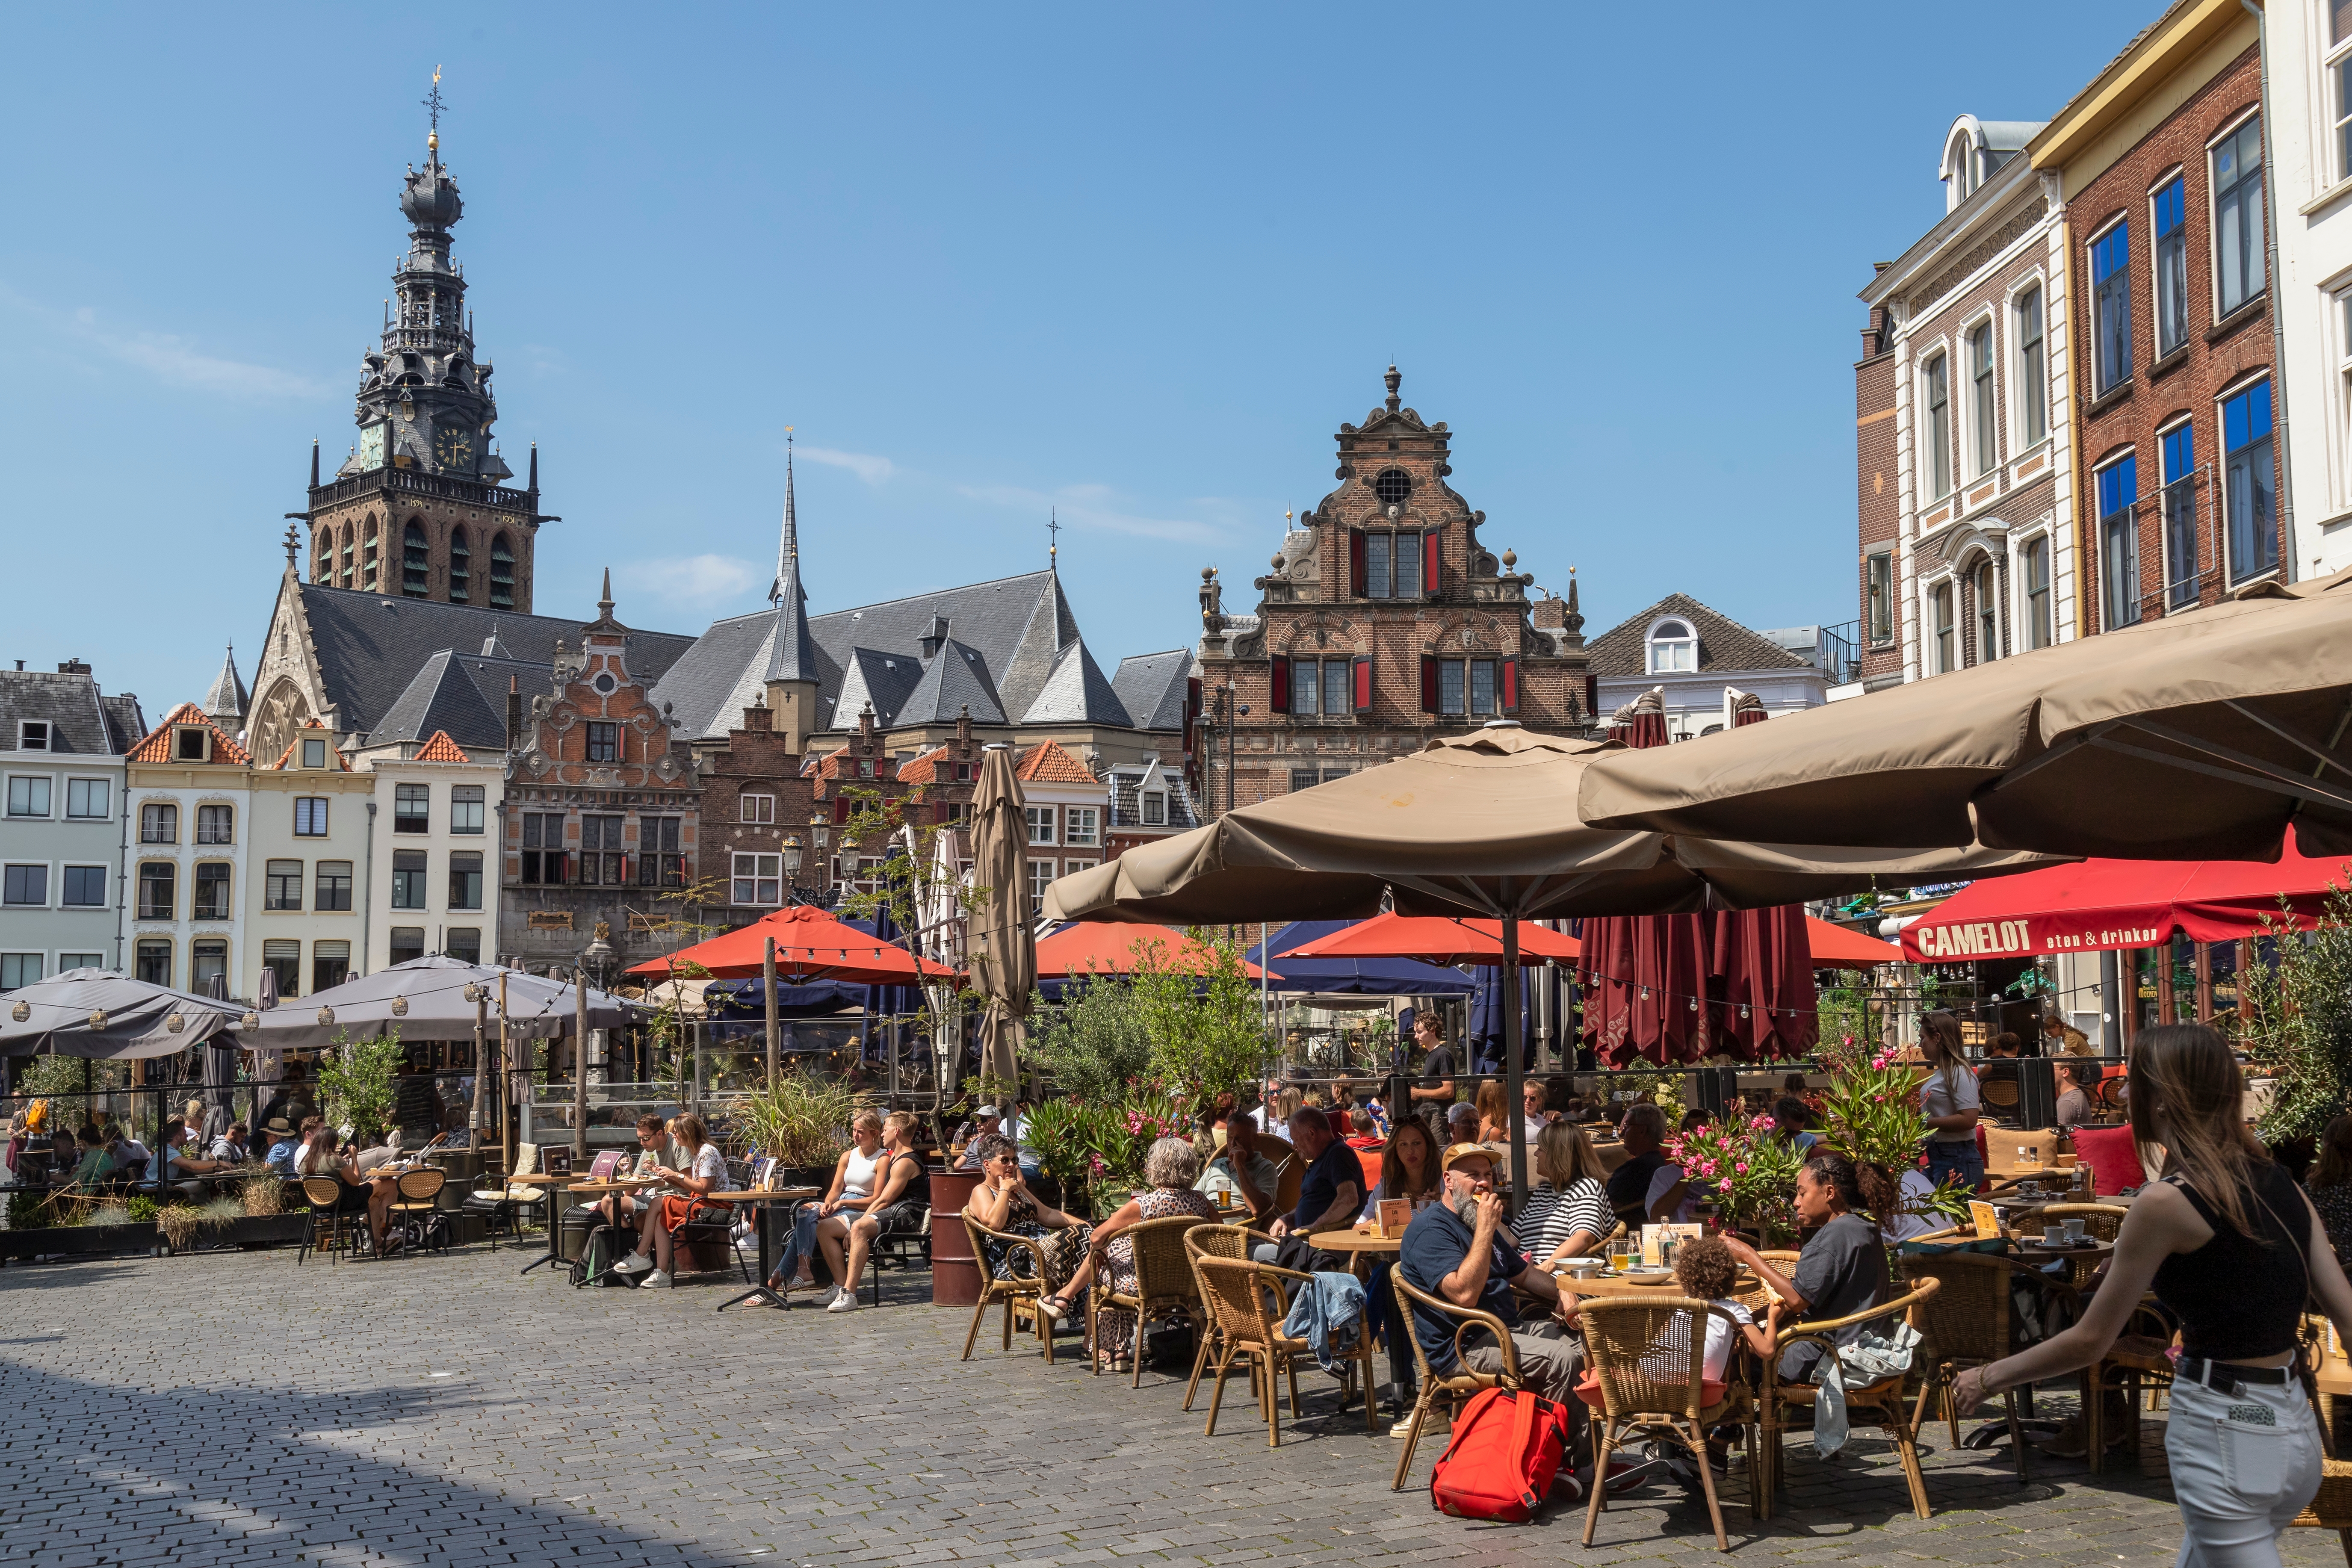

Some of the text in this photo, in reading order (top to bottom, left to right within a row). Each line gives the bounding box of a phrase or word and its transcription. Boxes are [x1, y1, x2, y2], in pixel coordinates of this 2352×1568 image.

[1918, 920, 2157, 957] CAMELOT eten & drinken
